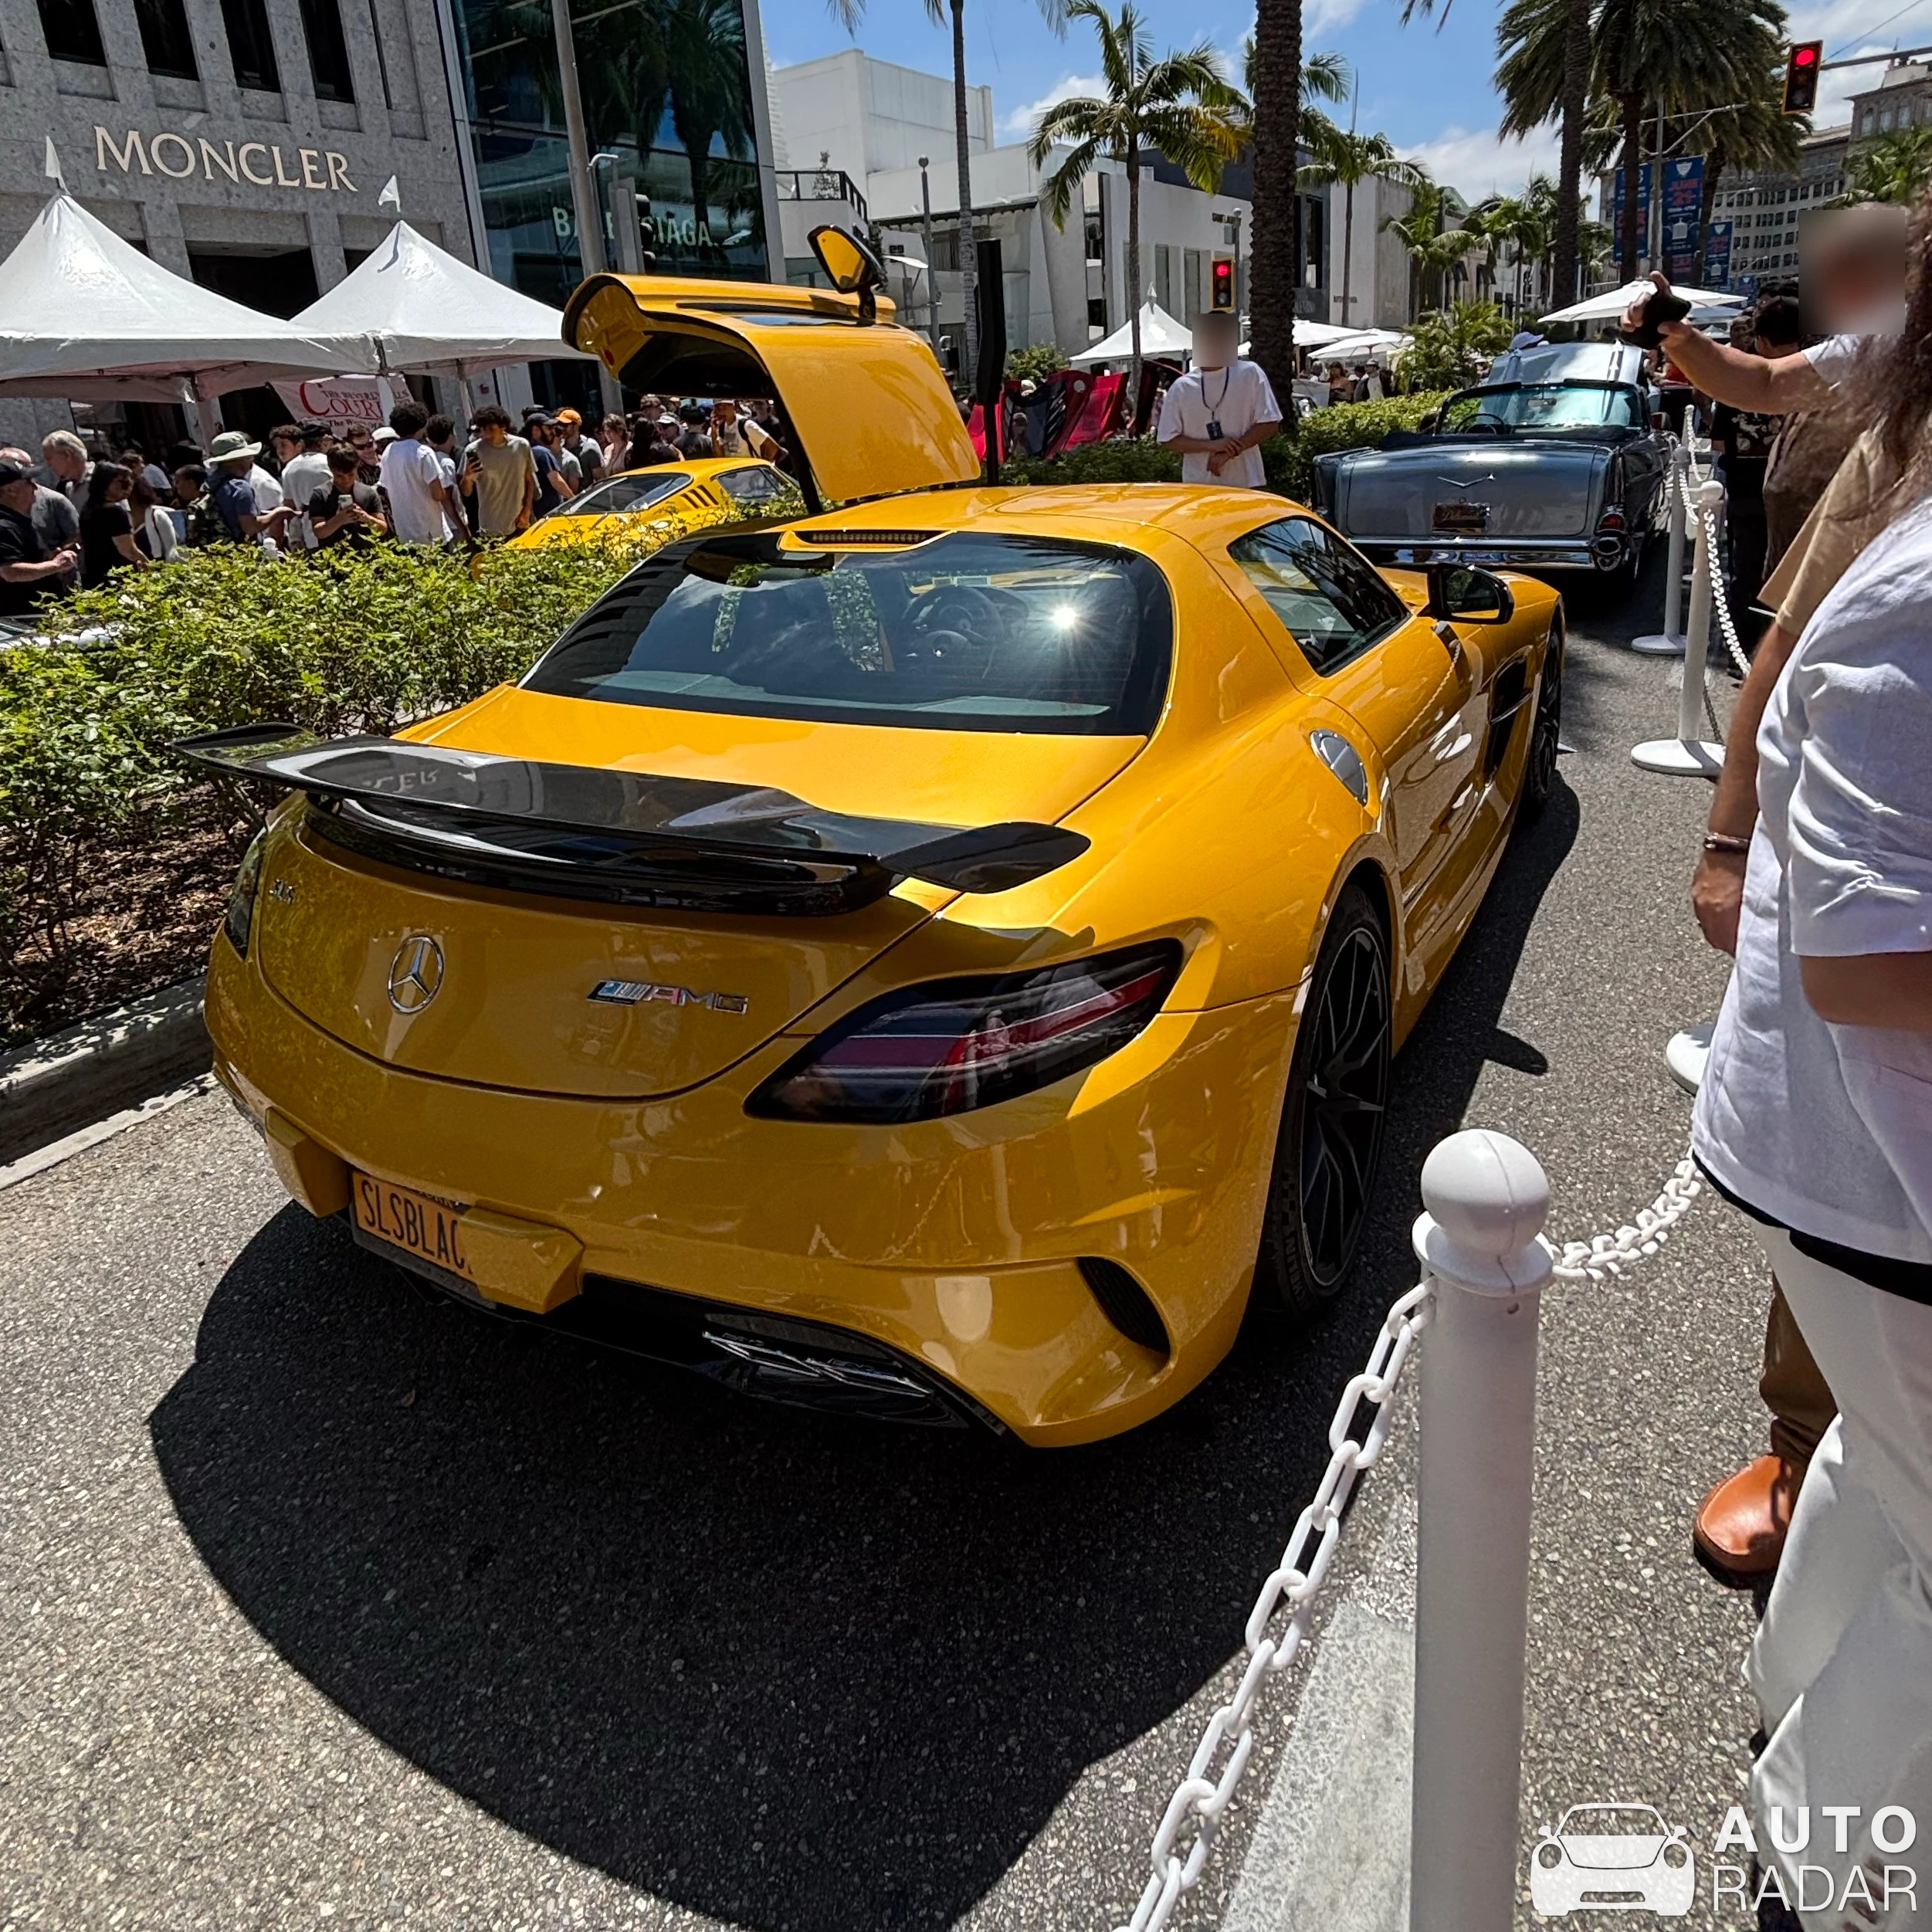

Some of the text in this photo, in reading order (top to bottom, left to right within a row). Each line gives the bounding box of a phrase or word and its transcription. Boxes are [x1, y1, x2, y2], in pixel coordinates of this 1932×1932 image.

[93, 125, 358, 192] MONCLER
[553, 207, 713, 247] BEIAGA
[642, 985, 749, 1015] AMG
[361, 1179, 473, 1274] SLSBLAC
